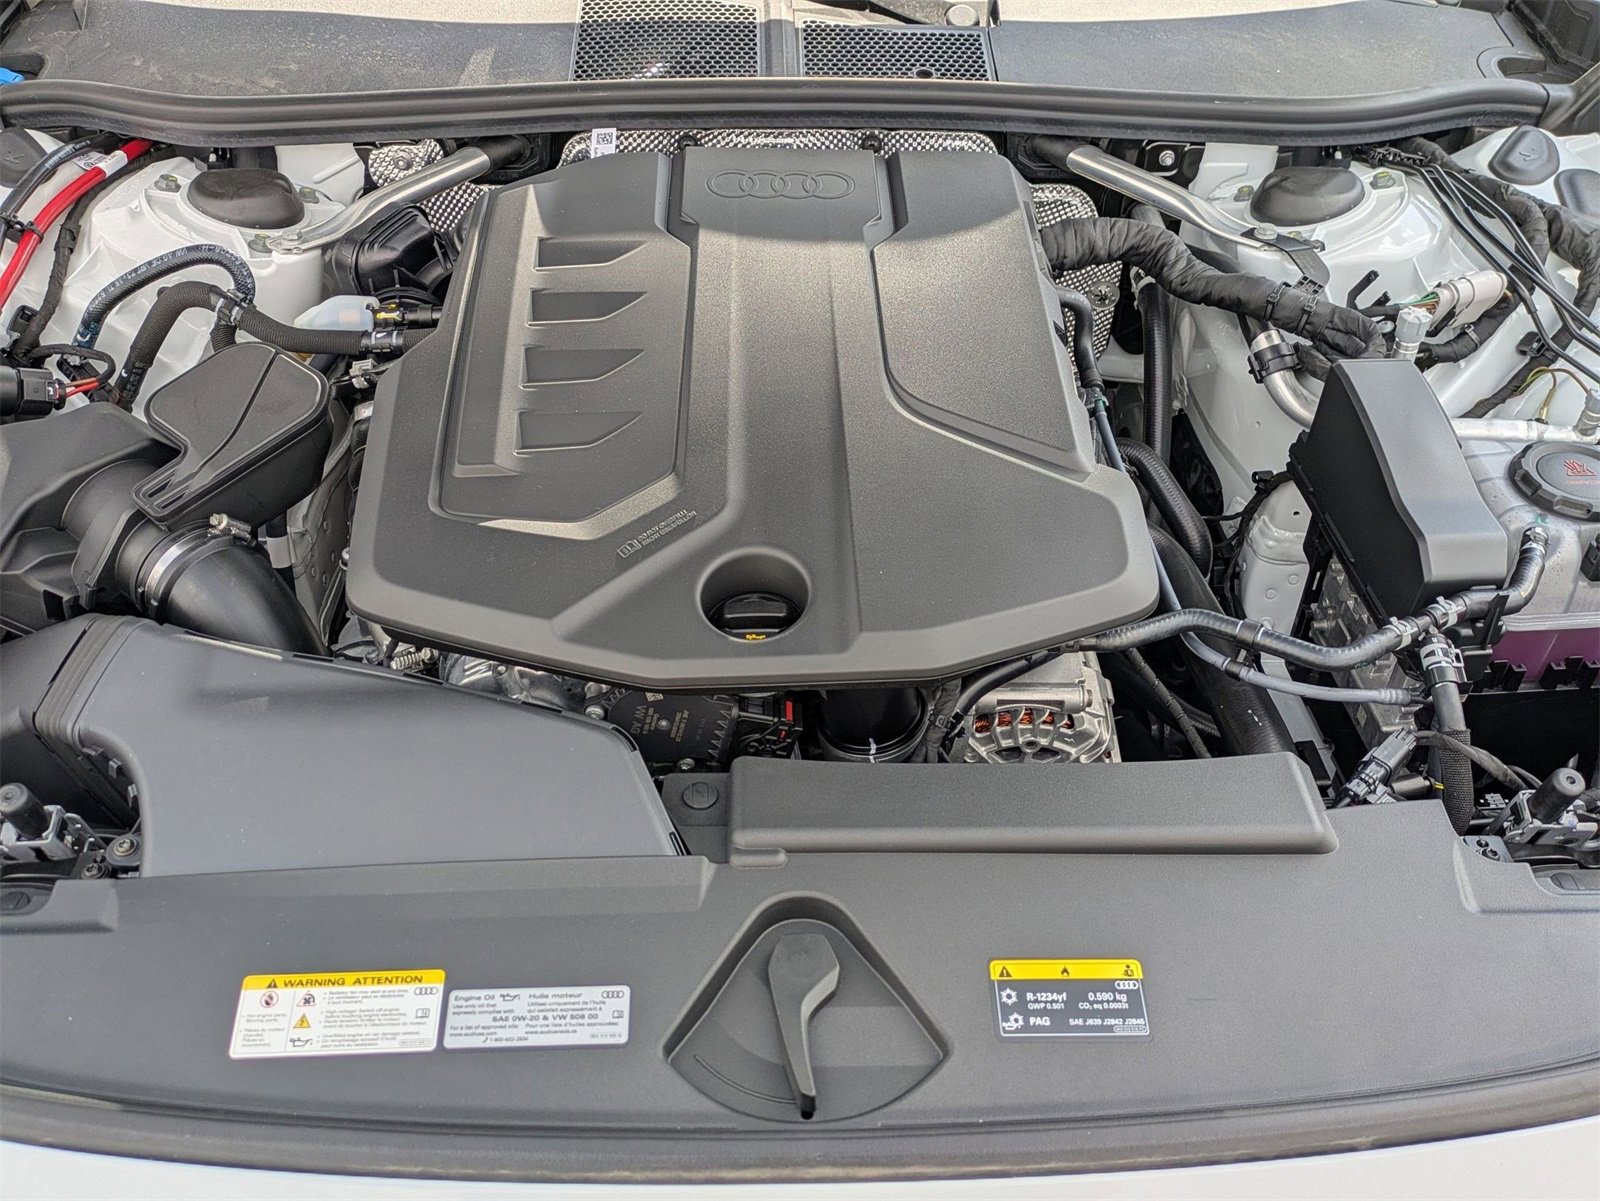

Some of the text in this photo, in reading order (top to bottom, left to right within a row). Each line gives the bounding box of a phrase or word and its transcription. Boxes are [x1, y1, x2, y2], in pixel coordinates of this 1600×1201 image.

[284, 975, 423, 988] WARNING ATTENTION
[1026, 992, 1127, 1002] R-1234yf 0.590 kg
[1029, 1016, 1050, 1026] PAG
